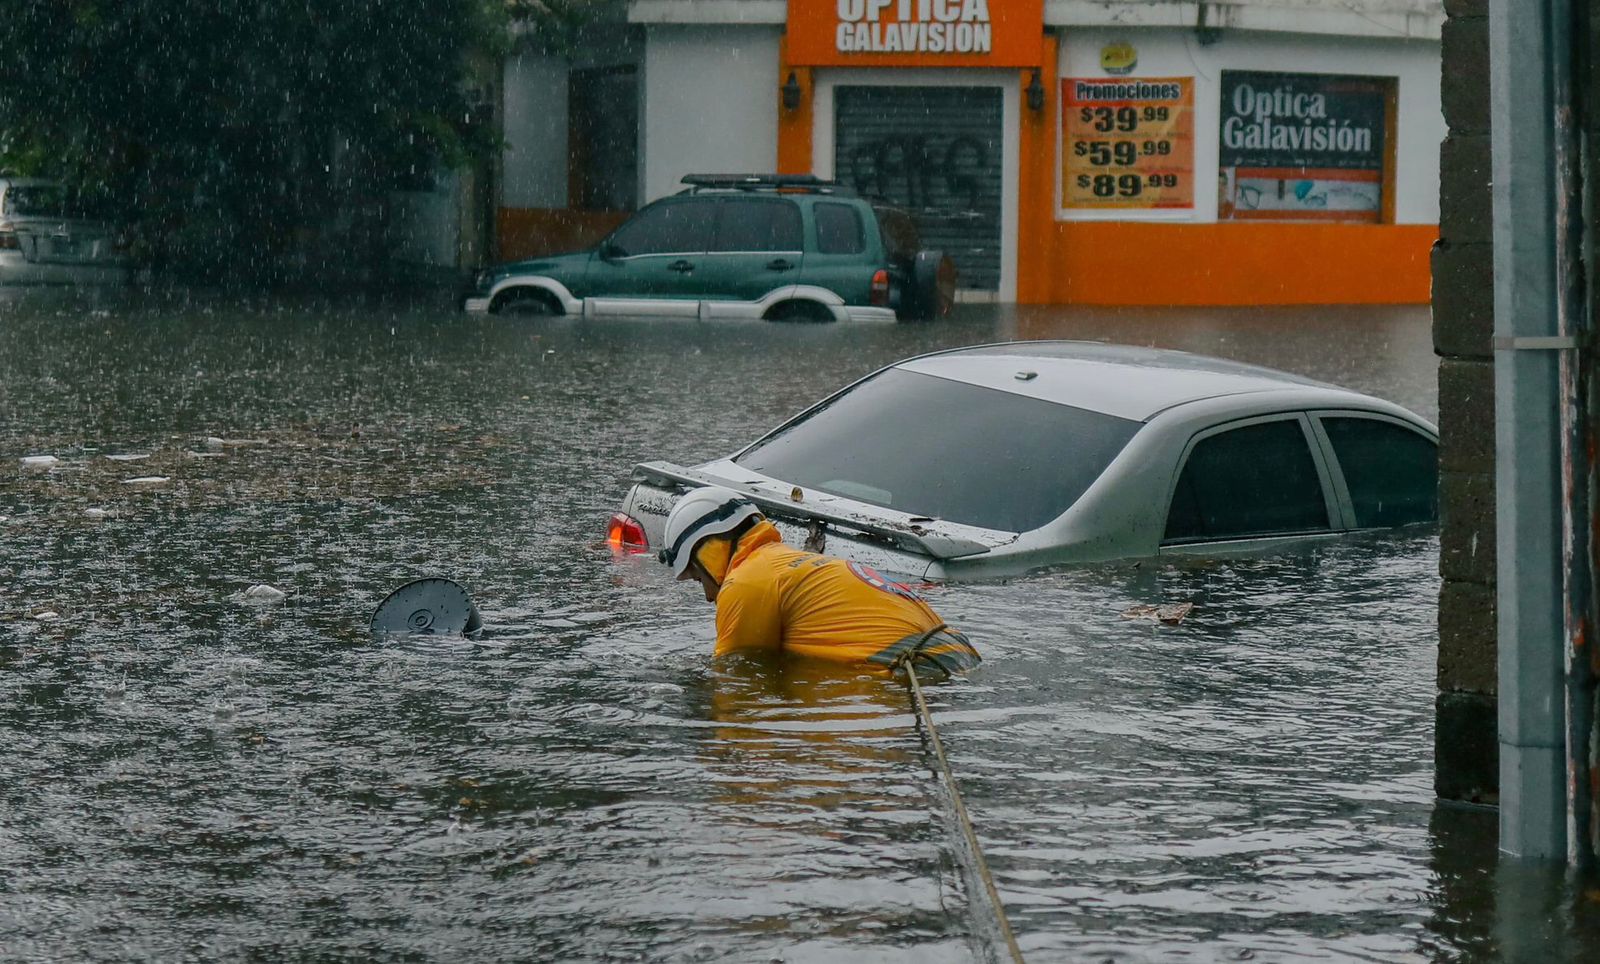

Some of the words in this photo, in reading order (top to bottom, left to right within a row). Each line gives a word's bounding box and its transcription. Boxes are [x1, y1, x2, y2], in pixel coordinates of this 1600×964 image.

[836, 22, 990, 52] GALAVISION
[1076, 81, 1181, 100] Promociones
[1233, 83, 1327, 122] Optica
[1081, 106, 1170, 132] $39.99
[1224, 116, 1372, 152] Galavisión
[1075, 140, 1171, 166] $59.99
[1077, 174, 1178, 197] $89.99
